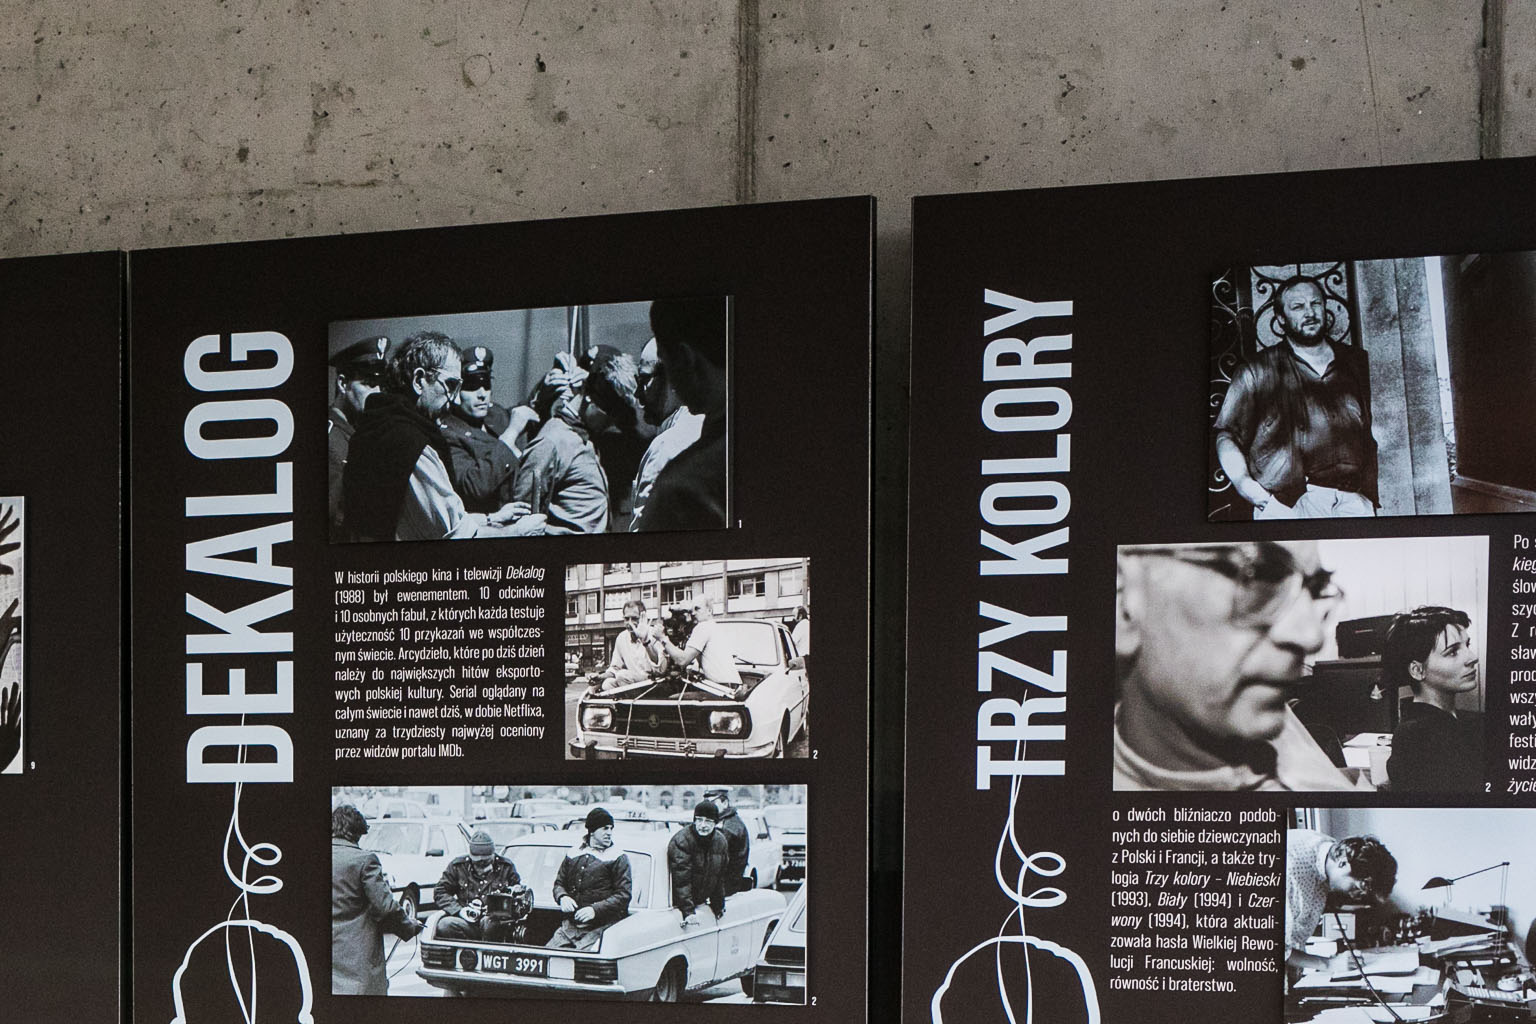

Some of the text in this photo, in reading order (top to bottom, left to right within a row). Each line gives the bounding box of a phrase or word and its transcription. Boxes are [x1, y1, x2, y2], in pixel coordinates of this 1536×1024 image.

[977, 288, 1073, 790] TRZY KOLORY
[1513, 534, 1530, 549] Po
[184, 331, 294, 783] DEKALOG
[334, 564, 545, 585] W historii polskiego kina telewizji Dekalog
[334, 585, 545, 605] (1988) był ewenementem. 10 odcinków
[340, 604, 545, 625] 10 osobnych fabuł, których każda testuje
[334, 624, 544, 645] użyteczność 10 przykazań we współczes-
[1511, 622, 1519, 638] Z
[334, 643, 545, 664] nym świecie. Arcydzieło, które po dziś dzień
[334, 664, 544, 684] należy do największych hitów eksporto-
[334, 684, 545, 703] wych polskiej kultury. Serial oglądany na
[1510, 692, 1536, 707] wsz
[334, 703, 544, 722] całym świecie nawet dziś, dobie Netflixa,
[335, 723, 545, 741] uznany za trzydziesty najwyżej oceniony
[335, 743, 464, 761] przez widzów portalu IMDb.
[812, 749, 818, 760] 2
[1485, 782, 1491, 793] 2
[1127, 807, 1280, 825] dwóch bliźniaczo podob-
[1112, 827, 1281, 847] nych do siebie dziewczynach
[1121, 848, 1280, 868] Polski Francji, także try-
[1111, 870, 1281, 889] logia Trzy kolory Niebieski
[1111, 890, 1279, 910] (1993), Biały (1994) Czer-
[1111, 912, 1278, 930] wony (1994), która aktuali-
[1110, 933, 1278, 953] zowała hasła Wielkiej Rewo-
[483, 954, 543, 973] WGT 3991
[1110, 954, 1278, 973] lucji Francuskiej: wolność,
[1109, 975, 1236, 992] równość braterstwo.
[811, 996, 817, 1006] 2
